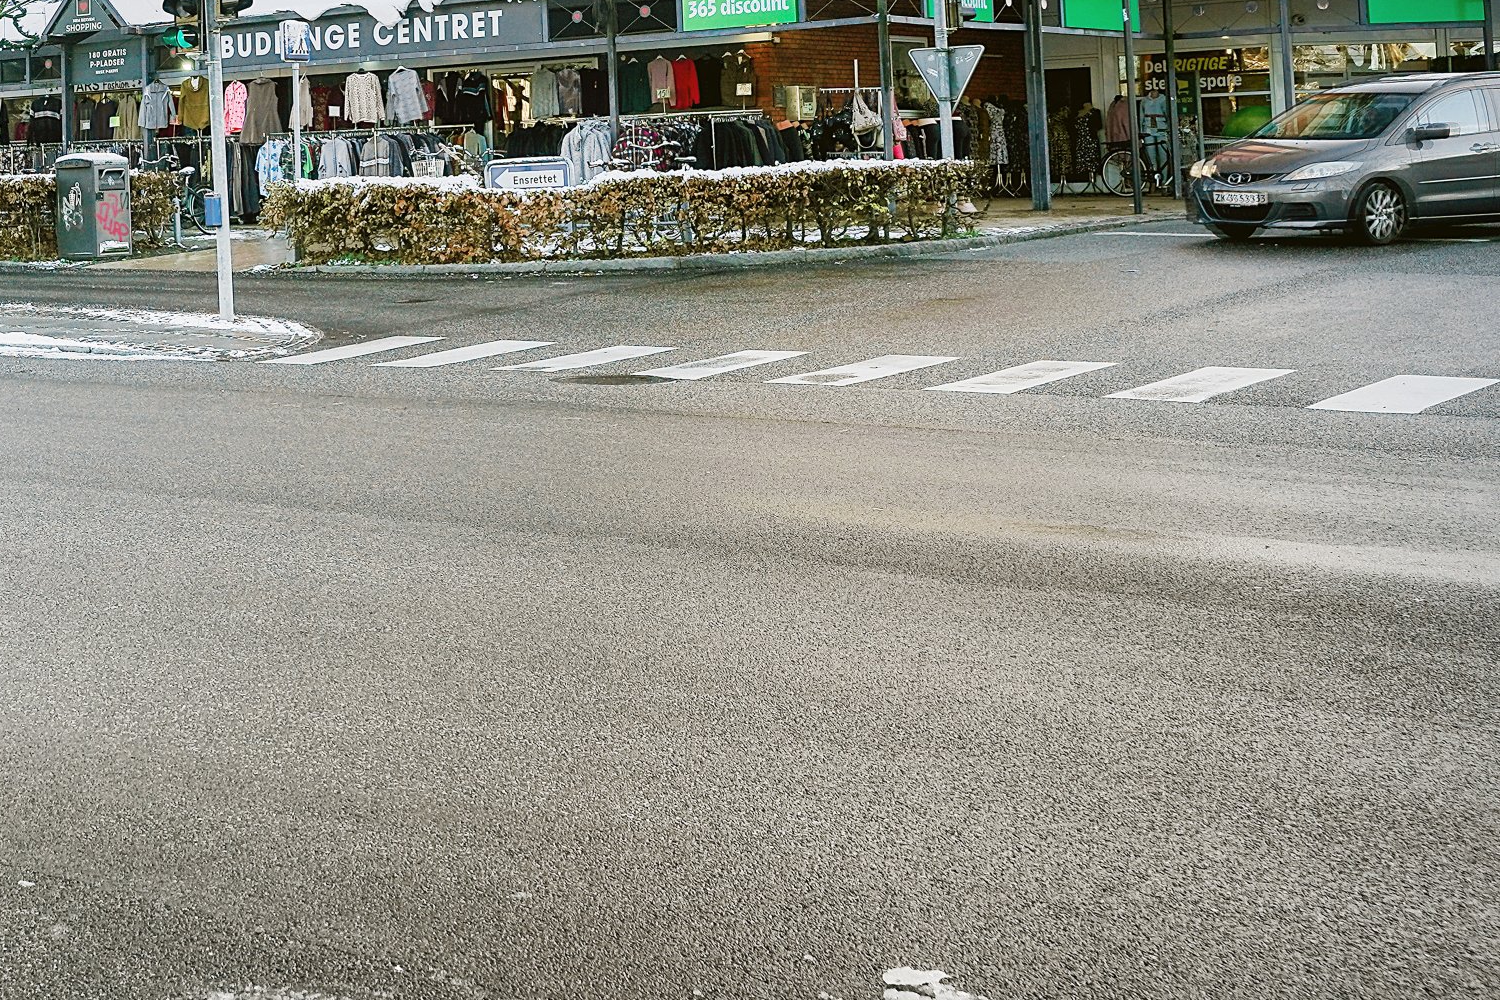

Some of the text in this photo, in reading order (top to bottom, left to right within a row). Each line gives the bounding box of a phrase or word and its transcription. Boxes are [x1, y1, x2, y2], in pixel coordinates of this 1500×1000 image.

[688, 0, 717, 19] 365
[66, 22, 102, 32] SHOPPING
[221, 10, 503, 59] BUDNGE CENTRET
[88, 48, 127, 59] 180 GRATIS
[89, 58, 125, 68] P-PLADSER
[1173, 56, 1228, 72] RIGTIGE
[1144, 74, 1243, 91] ste spare
[513, 174, 557, 185] Ensrettet
